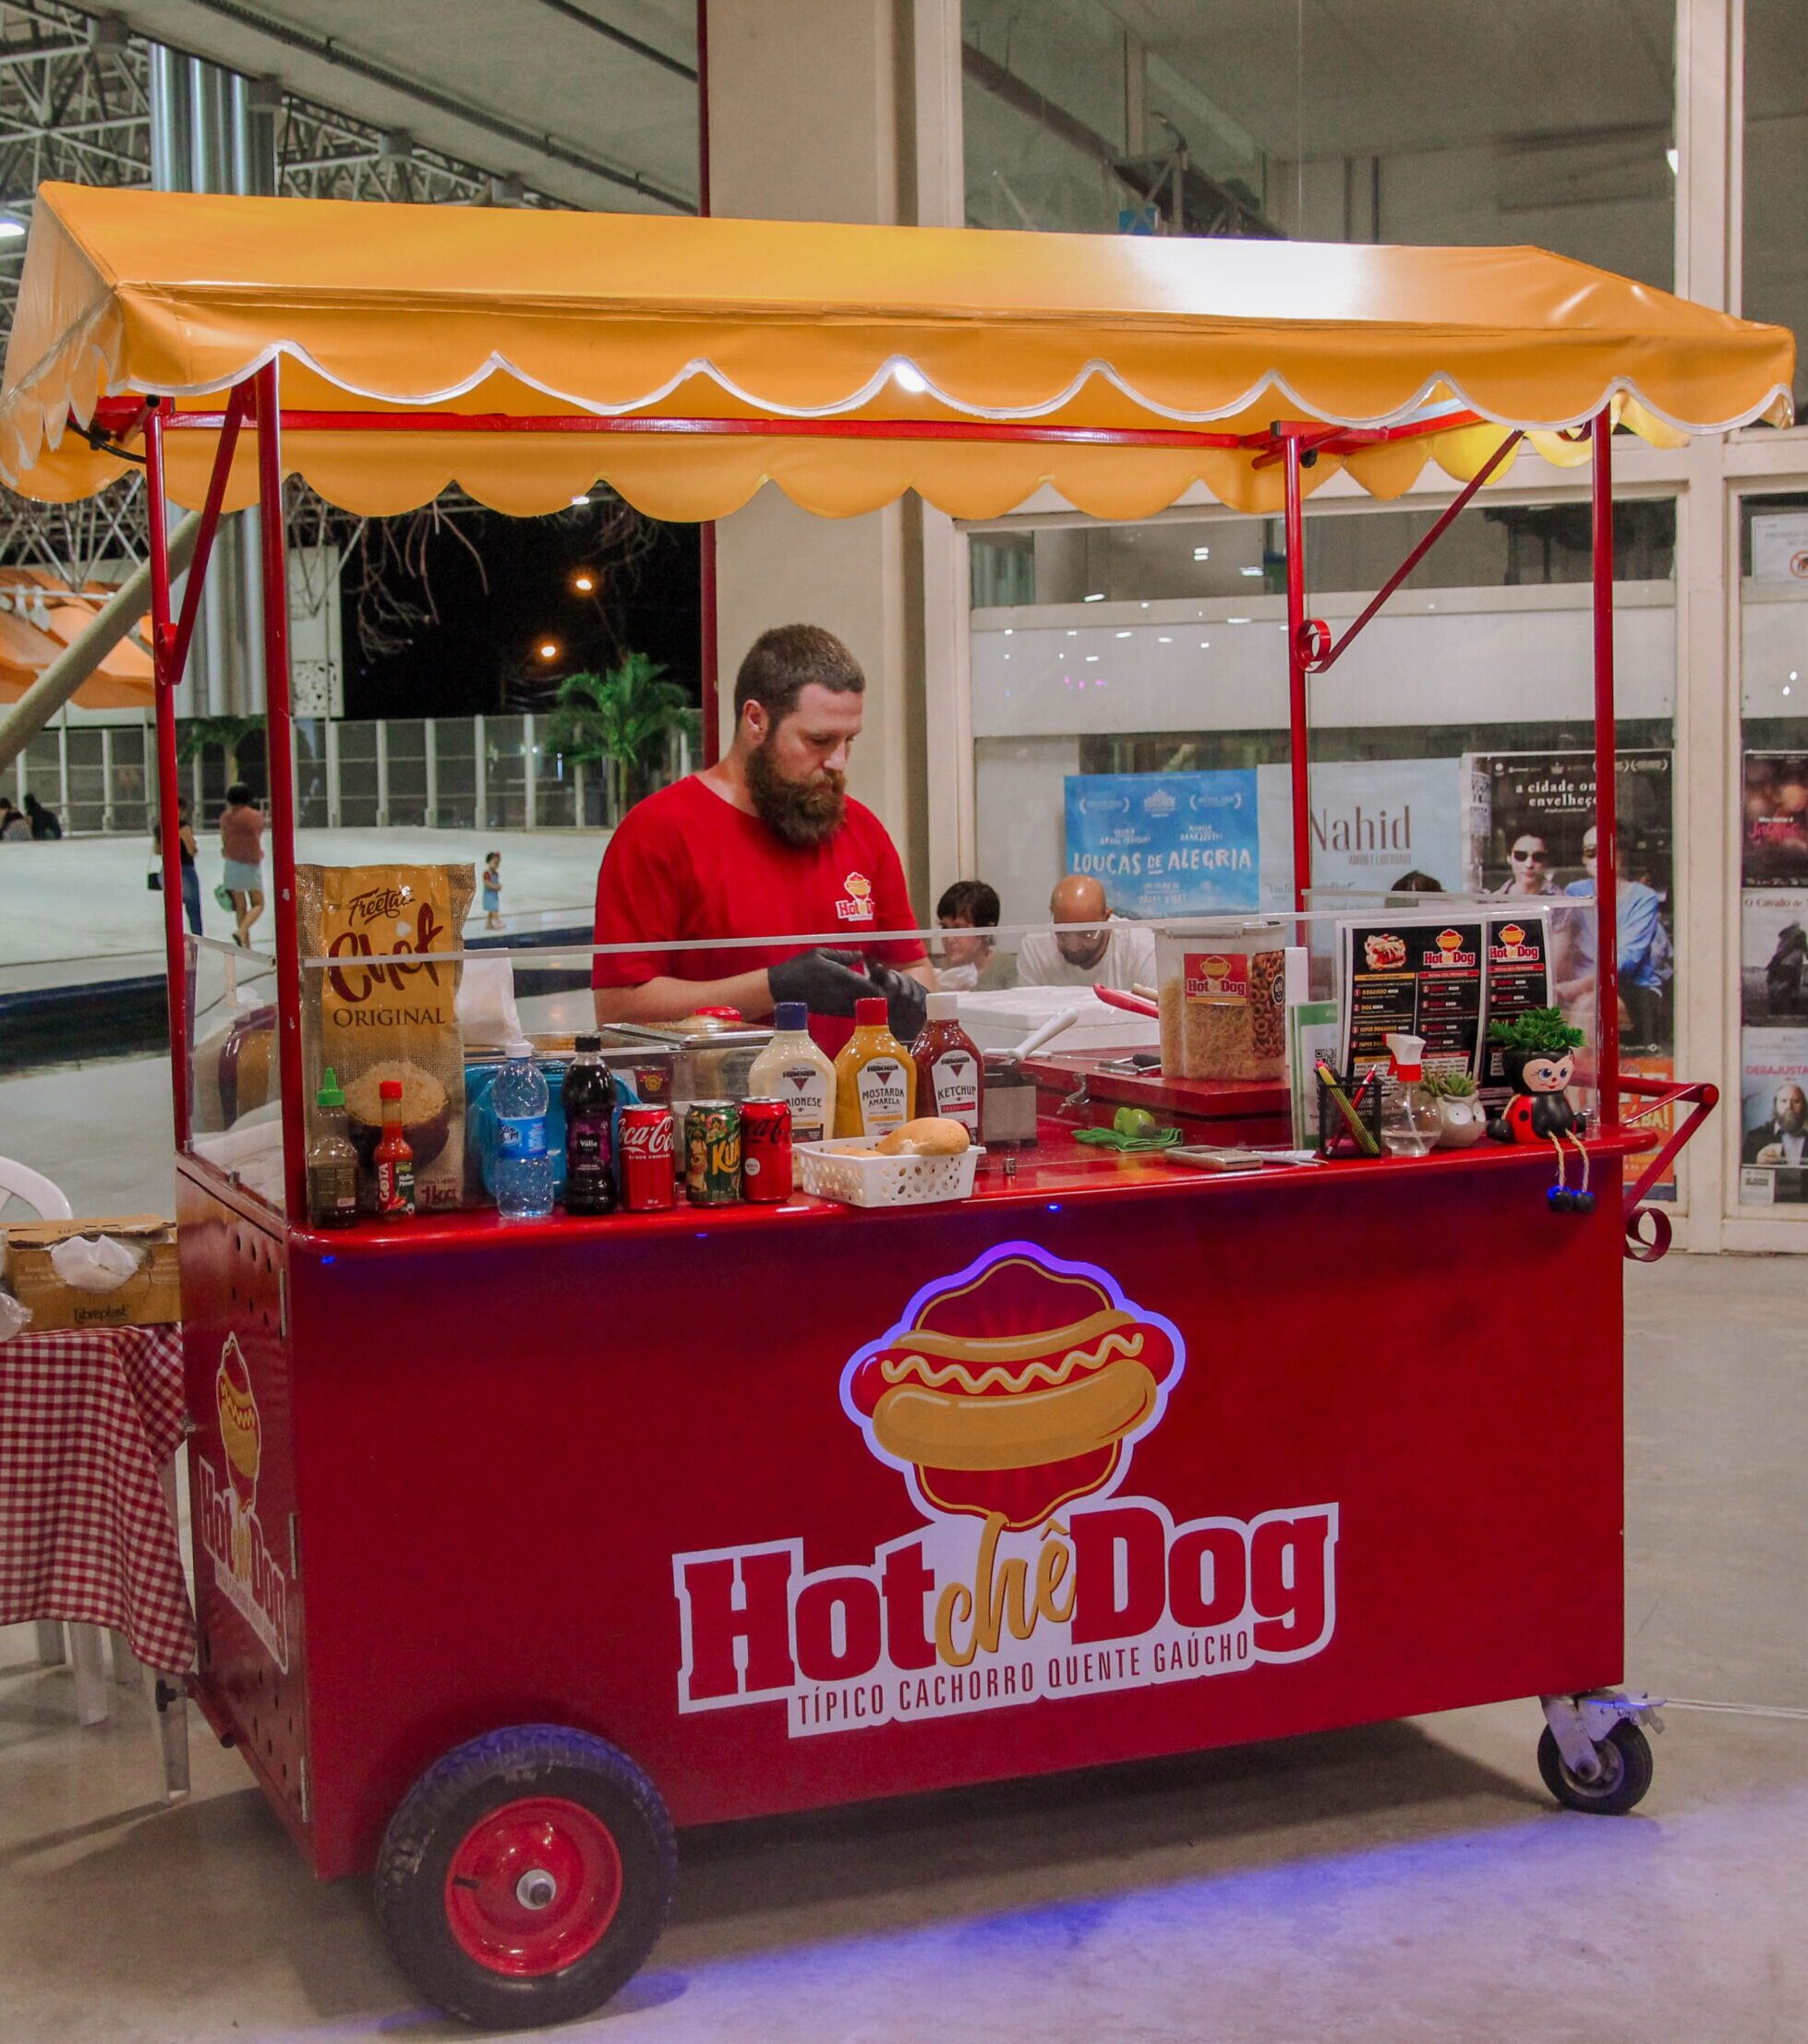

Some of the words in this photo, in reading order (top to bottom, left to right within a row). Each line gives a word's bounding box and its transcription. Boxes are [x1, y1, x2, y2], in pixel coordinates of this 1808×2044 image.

[1527, 779, 1574, 793] cidade
[1309, 805, 1411, 851] Nahid
[1073, 852, 1141, 876] LOUCAS
[1147, 854, 1163, 874] DE
[1168, 848, 1252, 872] ALEGRIA
[328, 903, 444, 1003] Chef
[1424, 953, 1443, 965] Hot
[1452, 952, 1475, 965] Dog
[1489, 947, 1508, 958] Hot
[1517, 946, 1538, 959] Dog
[1187, 980, 1210, 992] Hot
[1221, 980, 1246, 995] Dog
[333, 1007, 446, 1028] ORIGINAL
[862, 1088, 905, 1100] MOSTARDA
[937, 1085, 977, 1100] KETCHUP
[786, 1097, 822, 1108] AIONESE
[868, 1099, 900, 1107] AMARELA
[683, 1540, 935, 1701] Hot
[1068, 1507, 1330, 1650] Dog
[798, 1683, 885, 1725] TÍPICO
[898, 1663, 1034, 1711] CACHORRO
[1047, 1649, 1142, 1689] QUENTE
[1153, 1628, 1249, 1670] GAÚCHO
